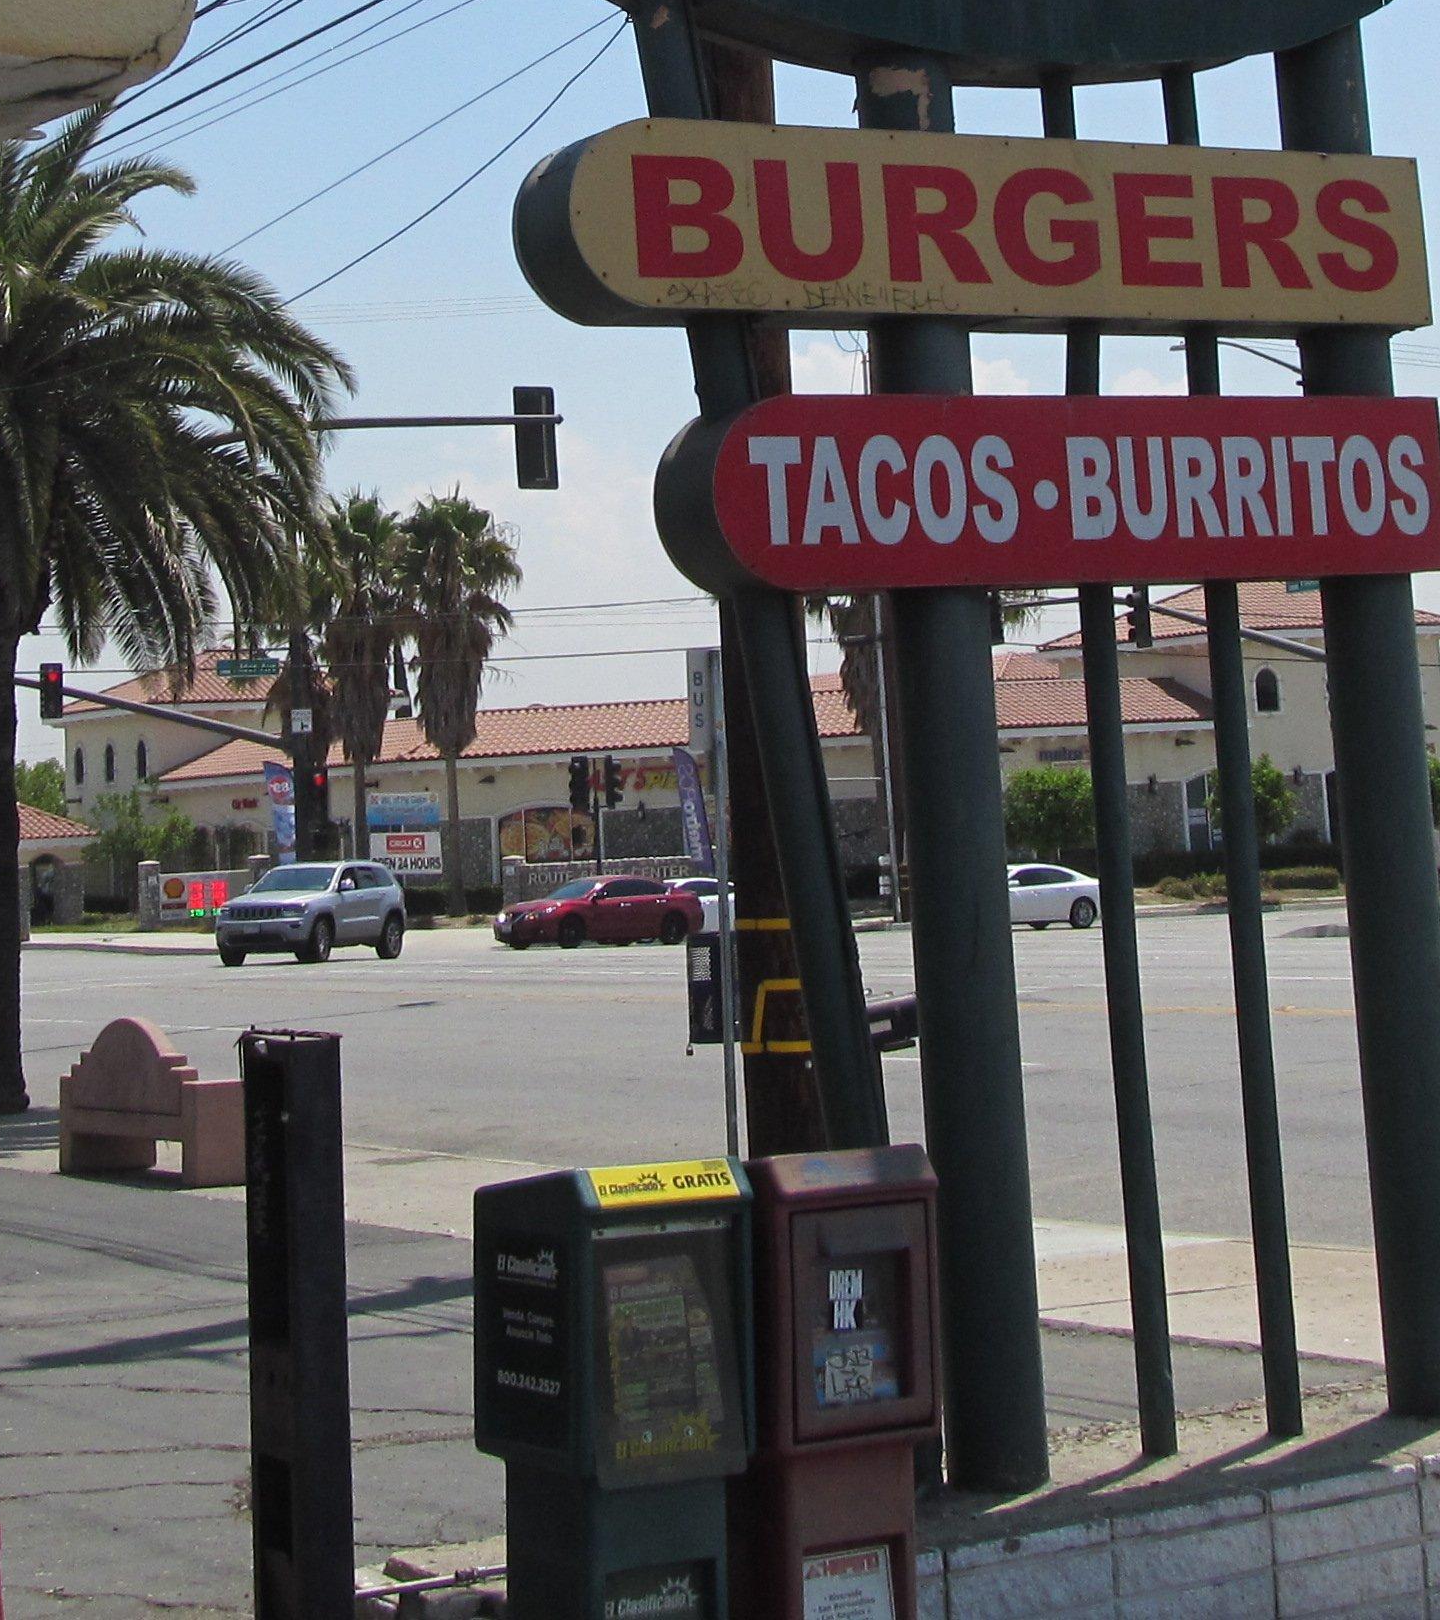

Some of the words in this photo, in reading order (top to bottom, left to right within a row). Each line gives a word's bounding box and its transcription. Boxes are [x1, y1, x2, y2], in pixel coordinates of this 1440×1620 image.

[630, 153, 1401, 293] BURGERS
[747, 433, 1019, 545] TACOS
[1065, 434, 1431, 541] BURRITOS
[692, 671, 705, 728] BUS
[410, 856, 441, 870] HOURS
[528, 870, 574, 885] ROUTE
[631, 864, 689, 879] CENTER
[672, 1171, 731, 1189] GRATIS
